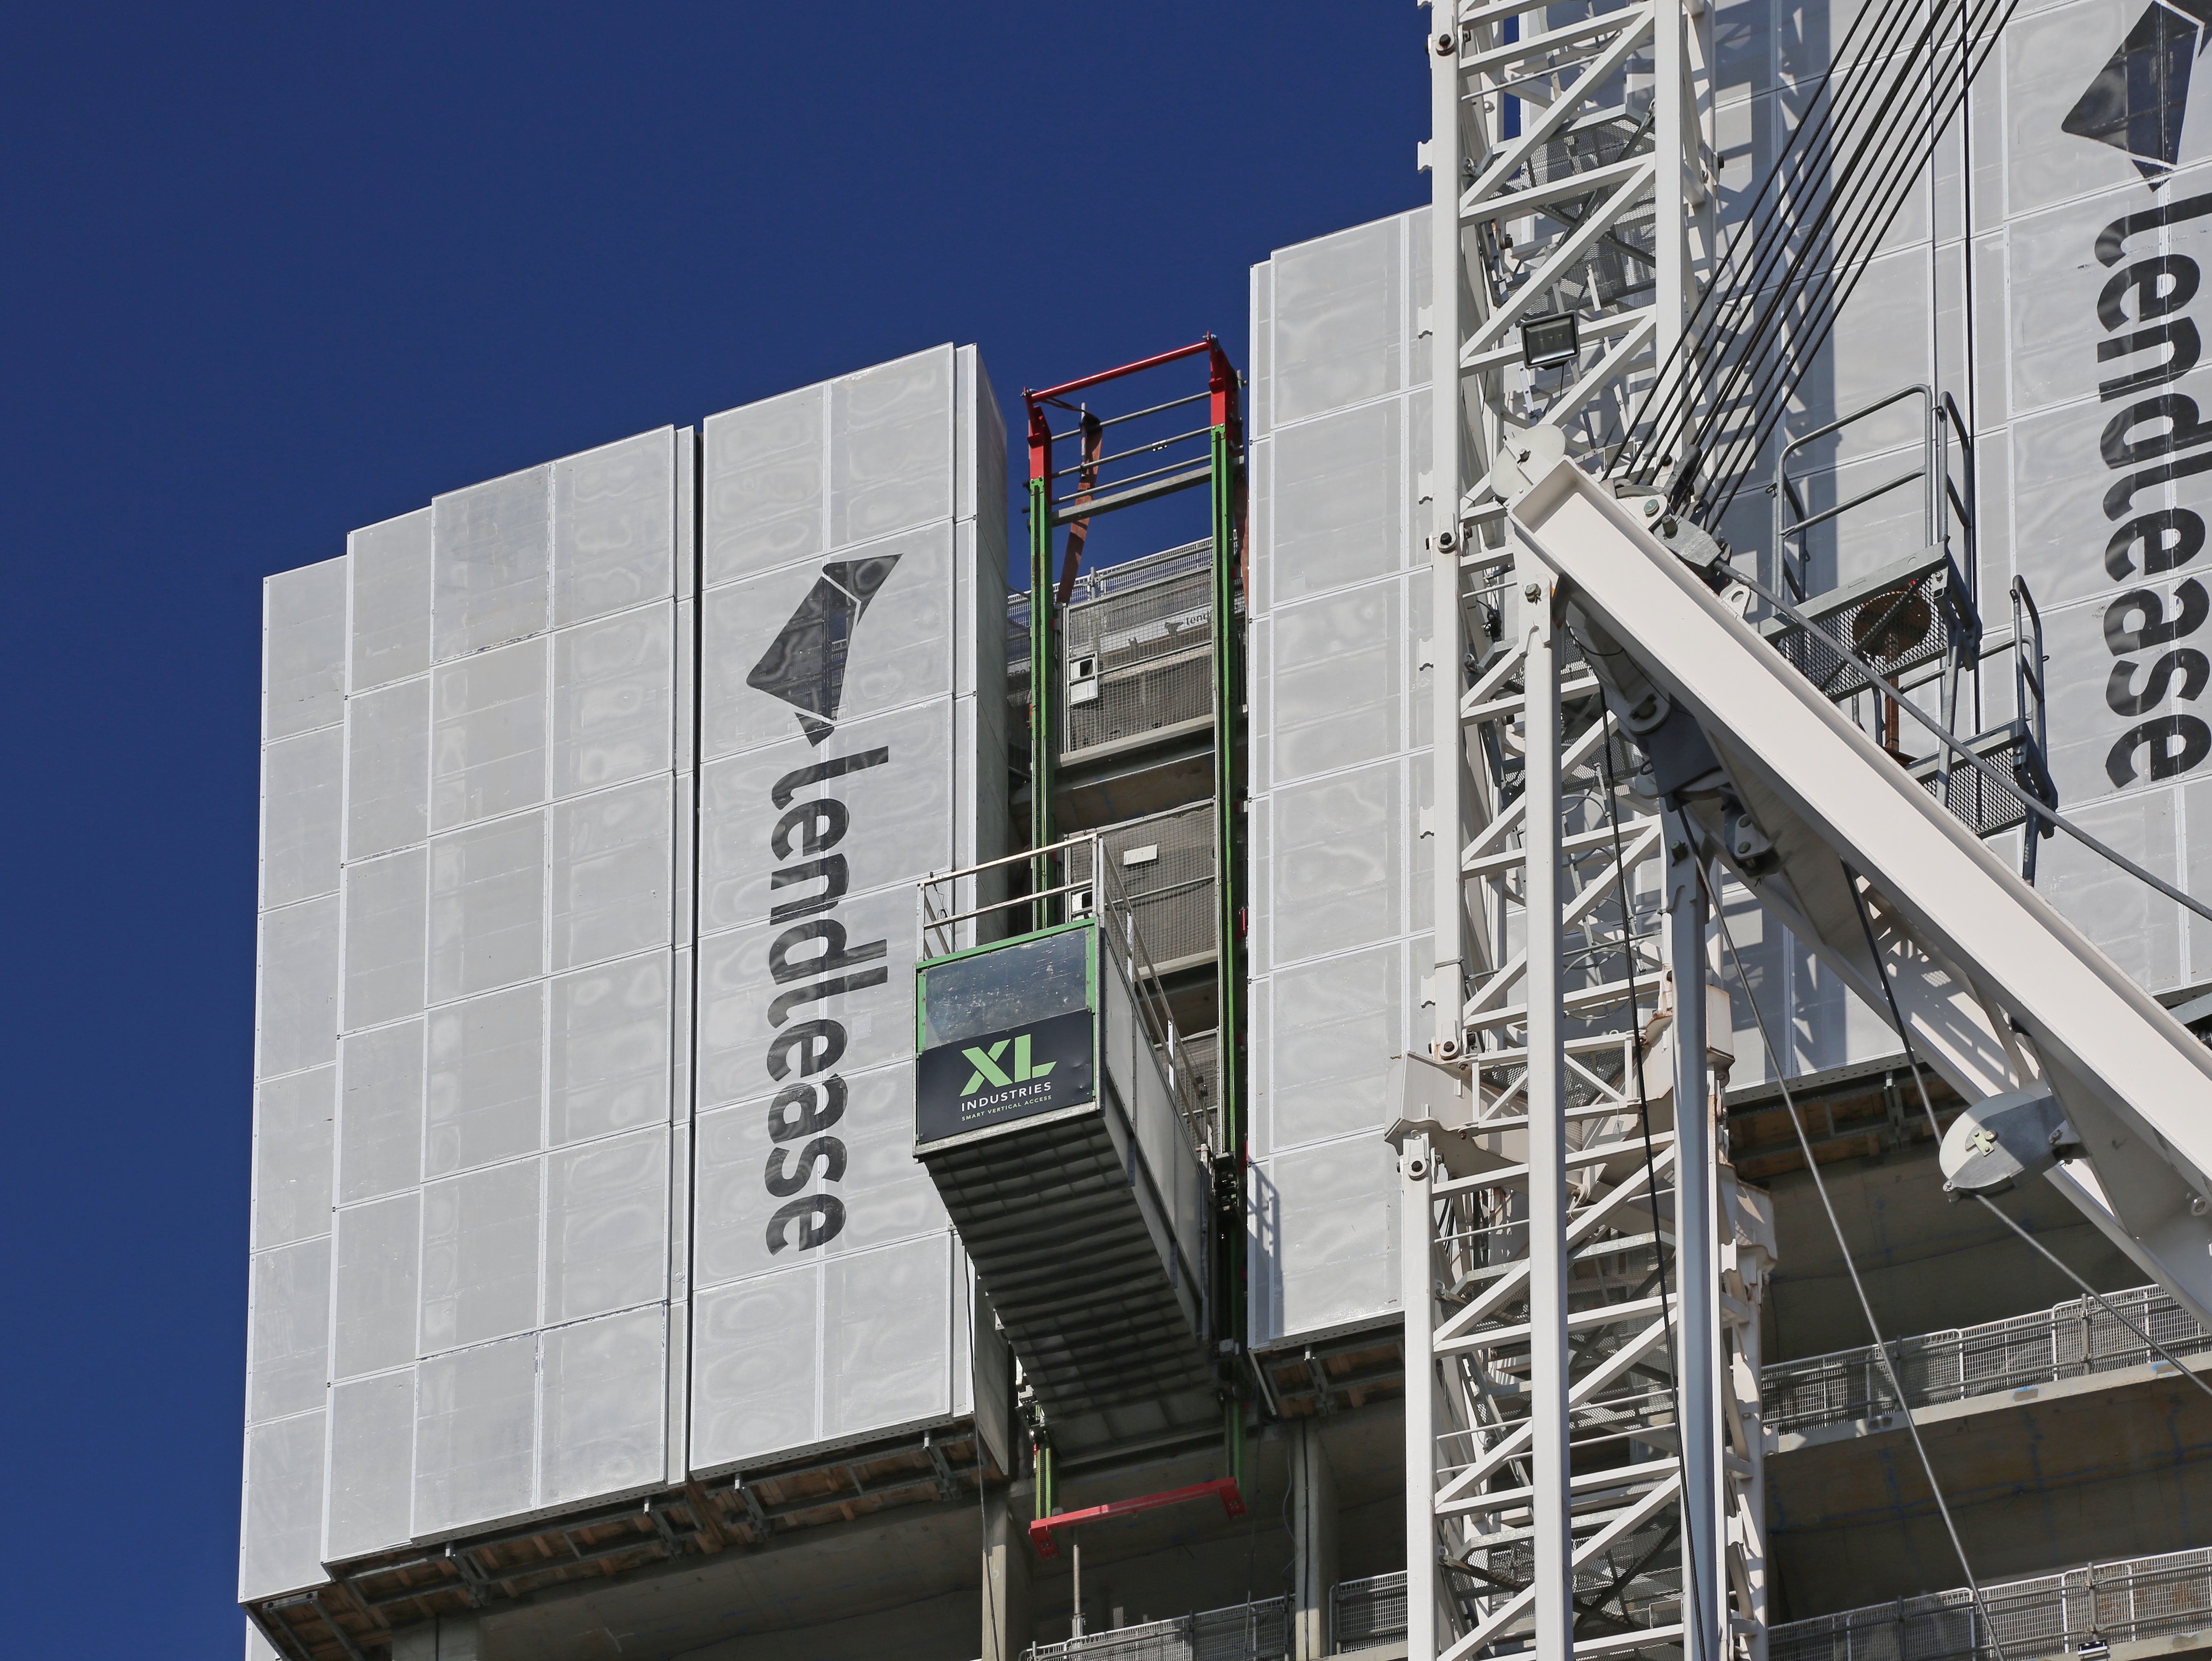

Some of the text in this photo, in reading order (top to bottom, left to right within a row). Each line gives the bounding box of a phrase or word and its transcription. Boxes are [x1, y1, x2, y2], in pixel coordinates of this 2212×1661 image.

[2095, 192, 2212, 788] lendlease
[765, 746, 889, 1255] lendlease
[959, 1034, 1057, 1097] XL
[962, 1081, 1052, 1112] INDUSTRIES
[962, 1095, 1052, 1121] SMART VERTICAL ACCESS
